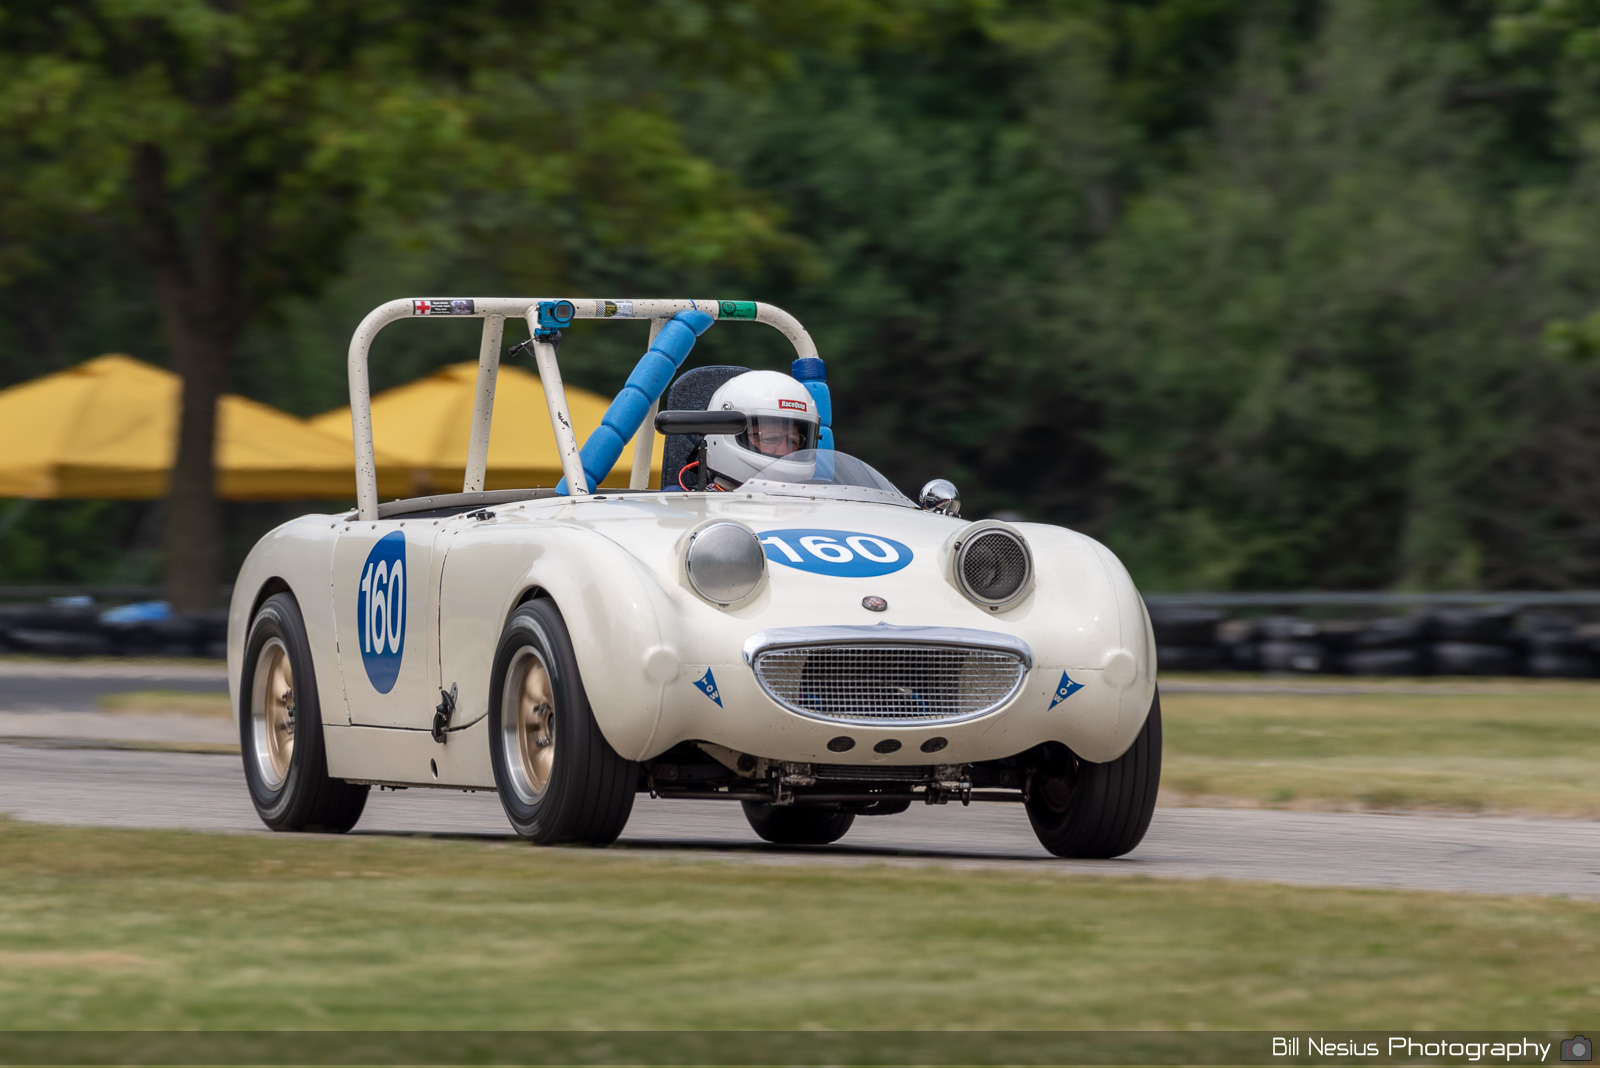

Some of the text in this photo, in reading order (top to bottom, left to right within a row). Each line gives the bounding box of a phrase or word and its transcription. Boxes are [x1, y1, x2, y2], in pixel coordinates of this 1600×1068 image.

[761, 536, 900, 563] 160
[361, 559, 404, 655] 160
[701, 677, 719, 700] TOW
[1053, 679, 1074, 703] TOW
